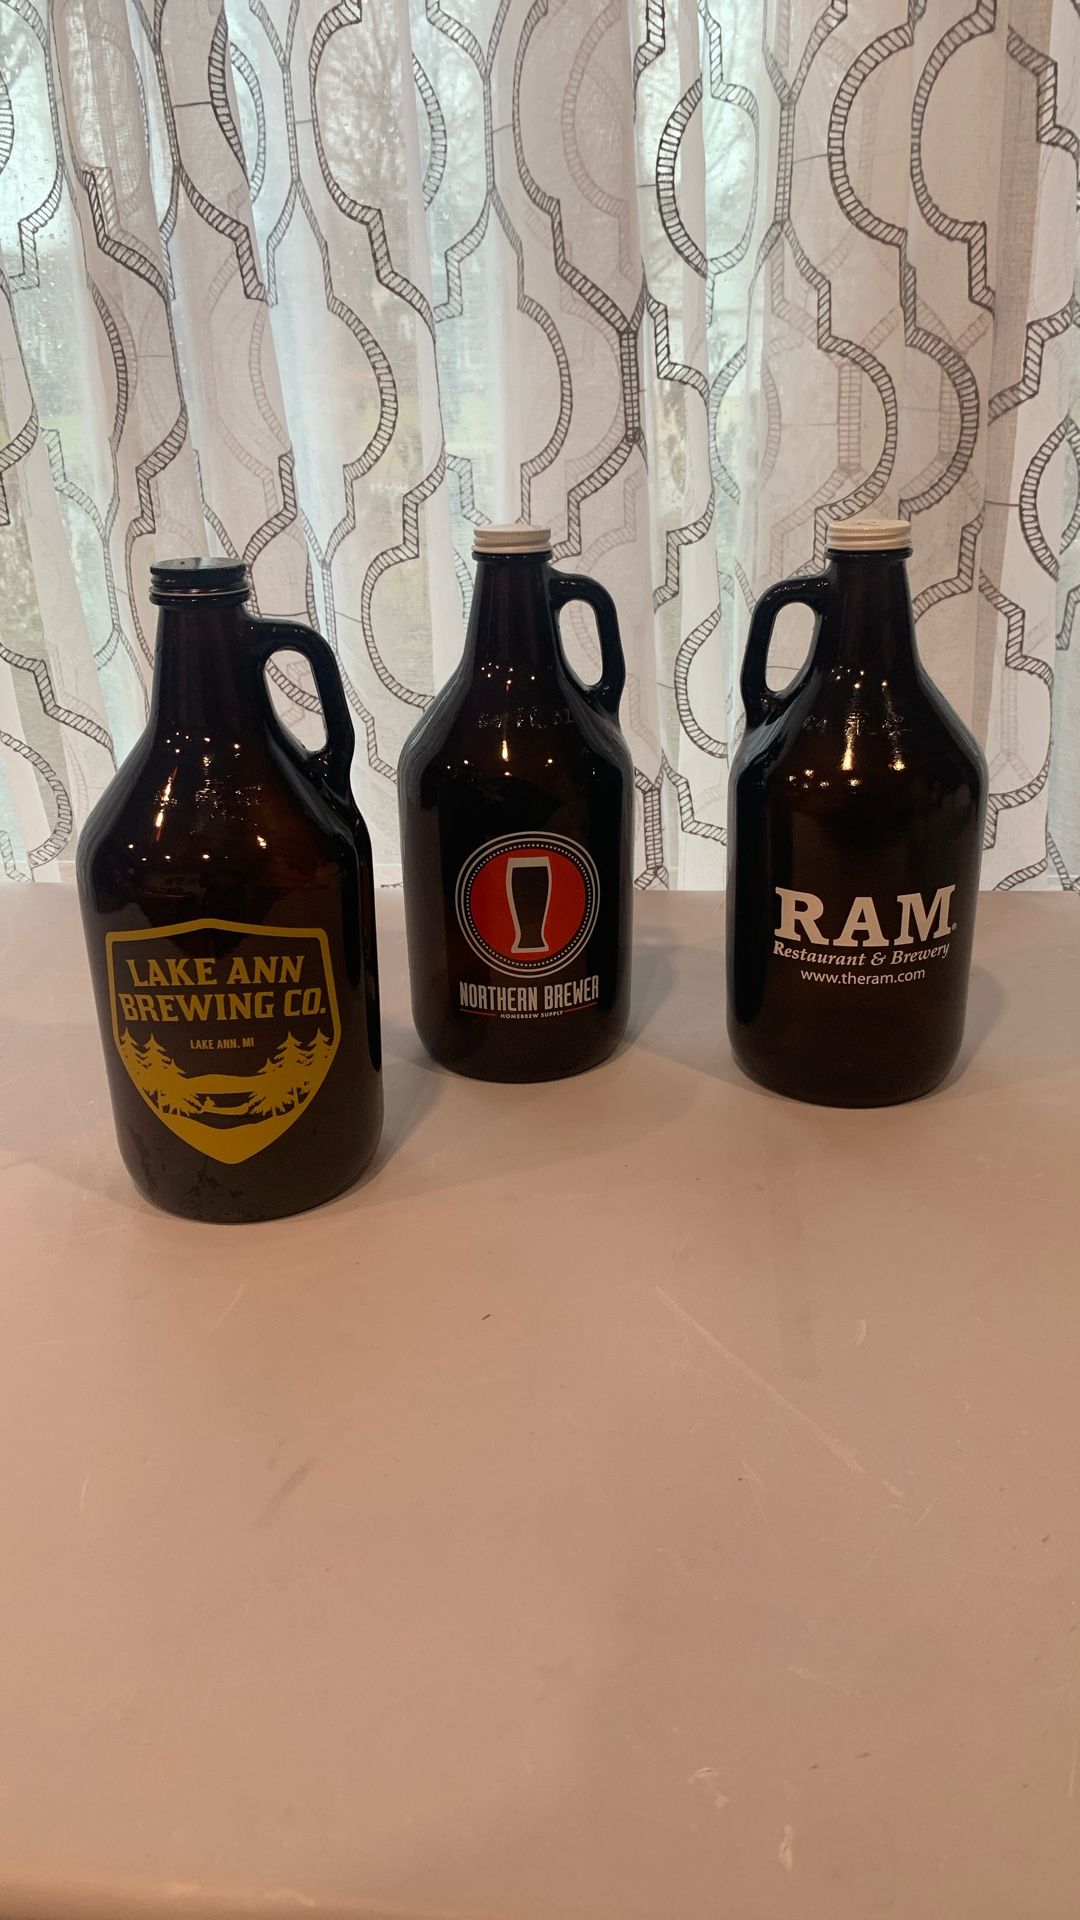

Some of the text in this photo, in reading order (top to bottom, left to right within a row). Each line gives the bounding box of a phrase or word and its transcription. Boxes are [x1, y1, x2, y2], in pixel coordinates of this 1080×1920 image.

[773, 940, 950, 966] Restaurant & Brewery
[126, 956, 304, 987] LAKE ANN
[800, 968, 926, 985] www.theram.com
[118, 988, 326, 1022] BREWING CO.
[459, 975, 599, 1012] NORTHERN BREWER
[540, 1010, 564, 1018] SUPPLY
[190, 1039, 215, 1050] LAKE
[242, 1037, 254, 1048] MI
